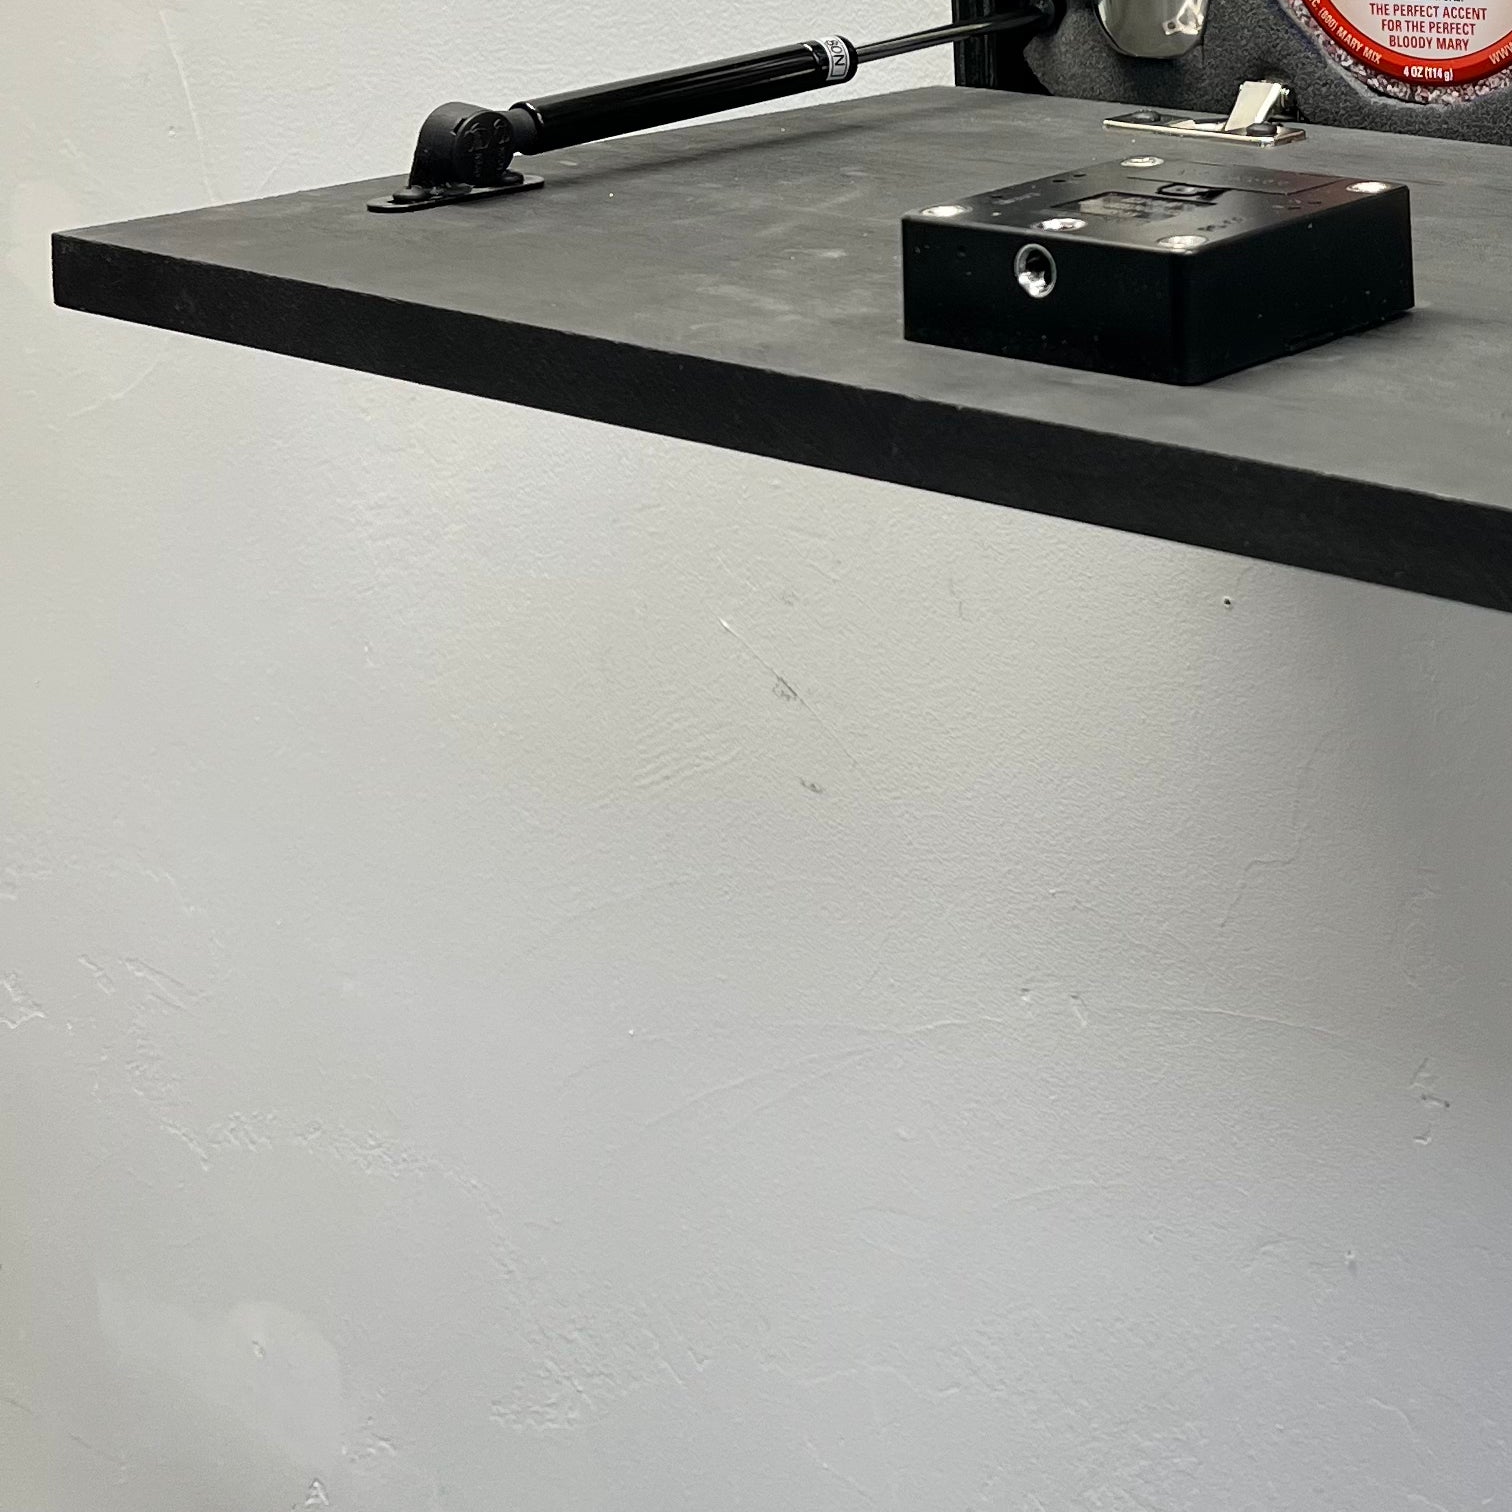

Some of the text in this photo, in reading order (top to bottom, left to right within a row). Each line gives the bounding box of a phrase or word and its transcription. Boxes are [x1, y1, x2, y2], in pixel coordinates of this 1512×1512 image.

[1369, 3, 1487, 20] THE PERFECT ACCENT
[1382, 19, 1476, 36] FOR THE PERFECT
[1337, 28, 1364, 53] MARY
[1363, 45, 1383, 65] MIX
[1390, 35, 1469, 51] BLOODY MARY
[1403, 66, 1409, 77] 4
[1411, 66, 1423, 78] OZ
